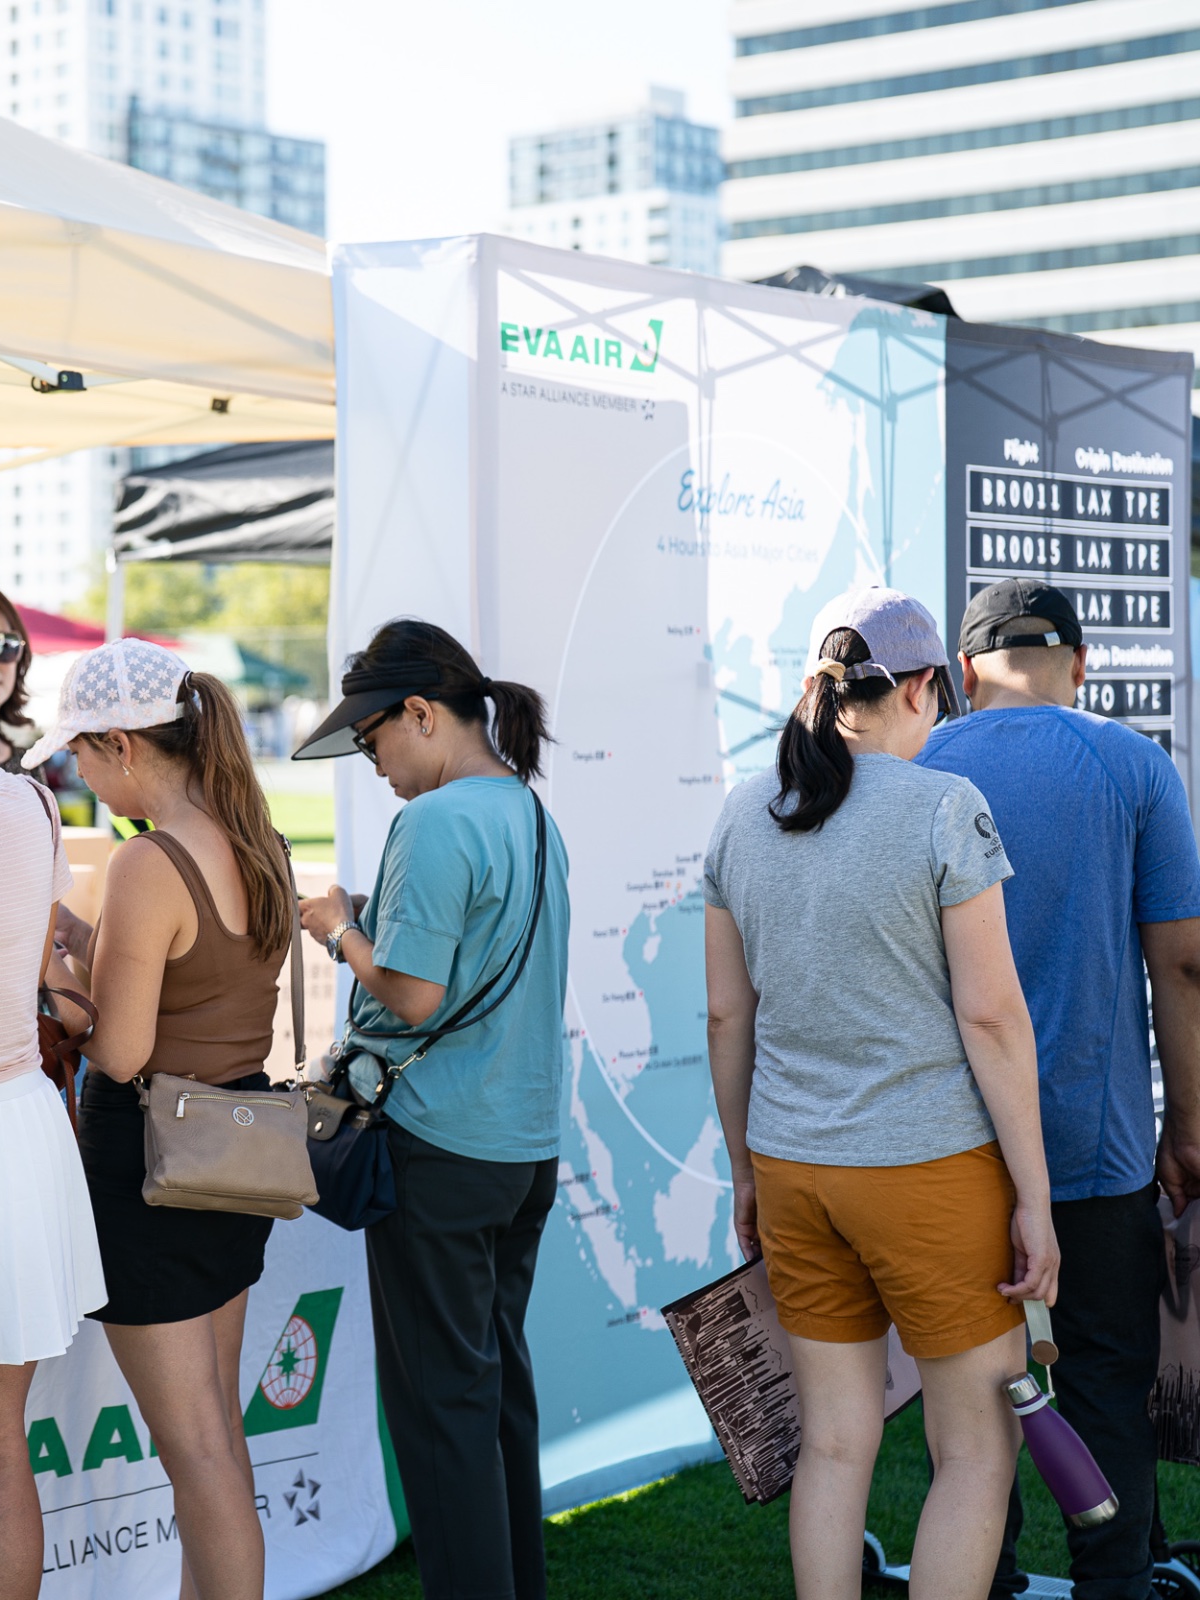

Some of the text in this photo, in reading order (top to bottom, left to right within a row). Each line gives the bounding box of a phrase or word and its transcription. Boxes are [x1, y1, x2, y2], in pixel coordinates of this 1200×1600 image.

[501, 382, 637, 412] A STAR ALLIANCE MEMBER
[1004, 437, 1039, 466] Flight
[1075, 446, 1174, 476] Origin Destination
[678, 467, 806, 531] Explore Asia
[1076, 487, 1111, 516] LAX
[1125, 490, 1160, 519] TPE
[657, 536, 665, 553] 4
[669, 536, 706, 558] Hours
[1076, 540, 1112, 568] LAX
[1125, 544, 1160, 571] TPE
[1076, 593, 1160, 622] LAX TPE
[1086, 643, 1174, 670] rigin Destination
[1077, 683, 1161, 711] SFO TPE
